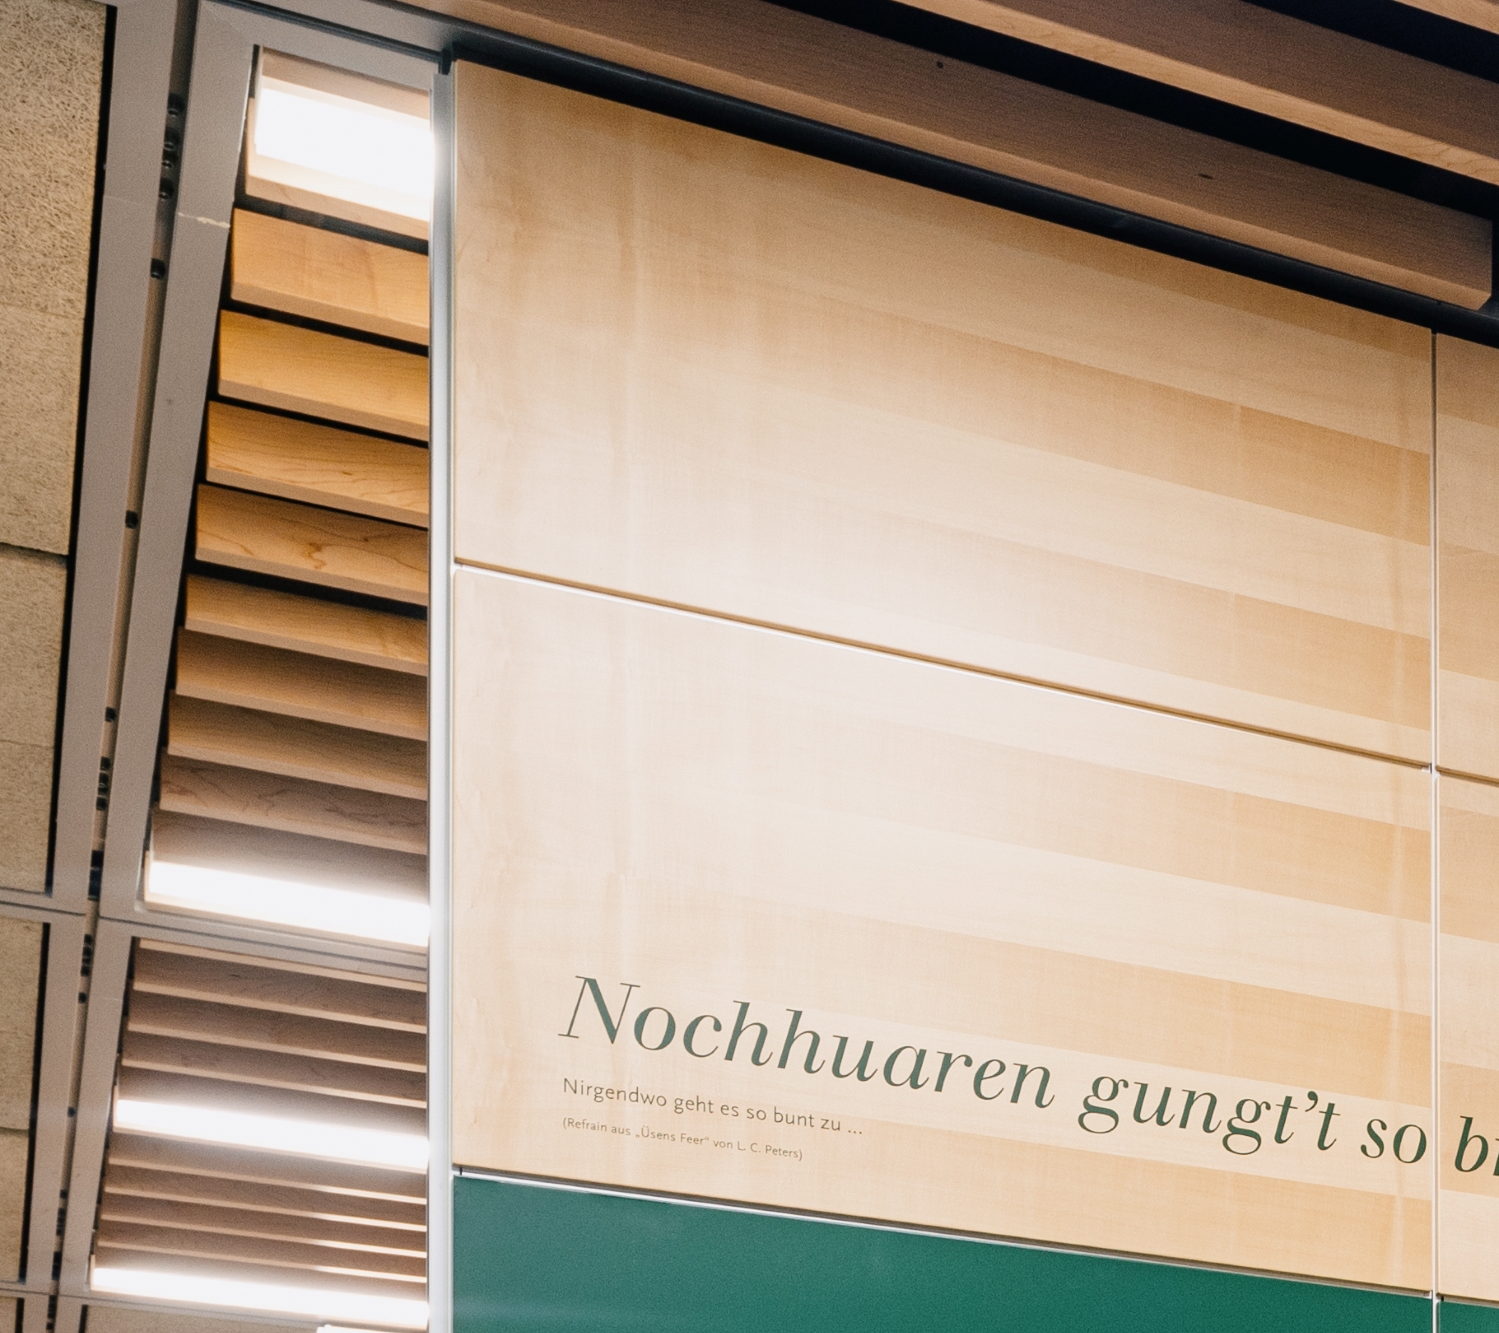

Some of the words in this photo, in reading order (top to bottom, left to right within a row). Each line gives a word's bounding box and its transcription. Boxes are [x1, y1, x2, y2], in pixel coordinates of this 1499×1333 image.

[558, 975, 1054, 1108] Nochhuaren
[1077, 1076, 1340, 1155] gungt’t
[1360, 1118, 1426, 1163] so
[563, 1077, 666, 1106] Nirgendwo
[673, 1094, 713, 1114] geht
[720, 1104, 738, 1117] es
[746, 1107, 766, 1120] so
[773, 1105, 814, 1127] bunt
[820, 1118, 840, 1131] zu
[562, 1117, 607, 1131] (Refrain
[610, 1125, 630, 1135] aus
[635, 1125, 675, 1141] „Üsens
[680, 1132, 709, 1145] Feer“
[712, 1140, 732, 1148] von
[737, 1141, 746, 1151] L.
[749, 1142, 760, 1152] C.
[764, 1144, 802, 1161] Peters)
